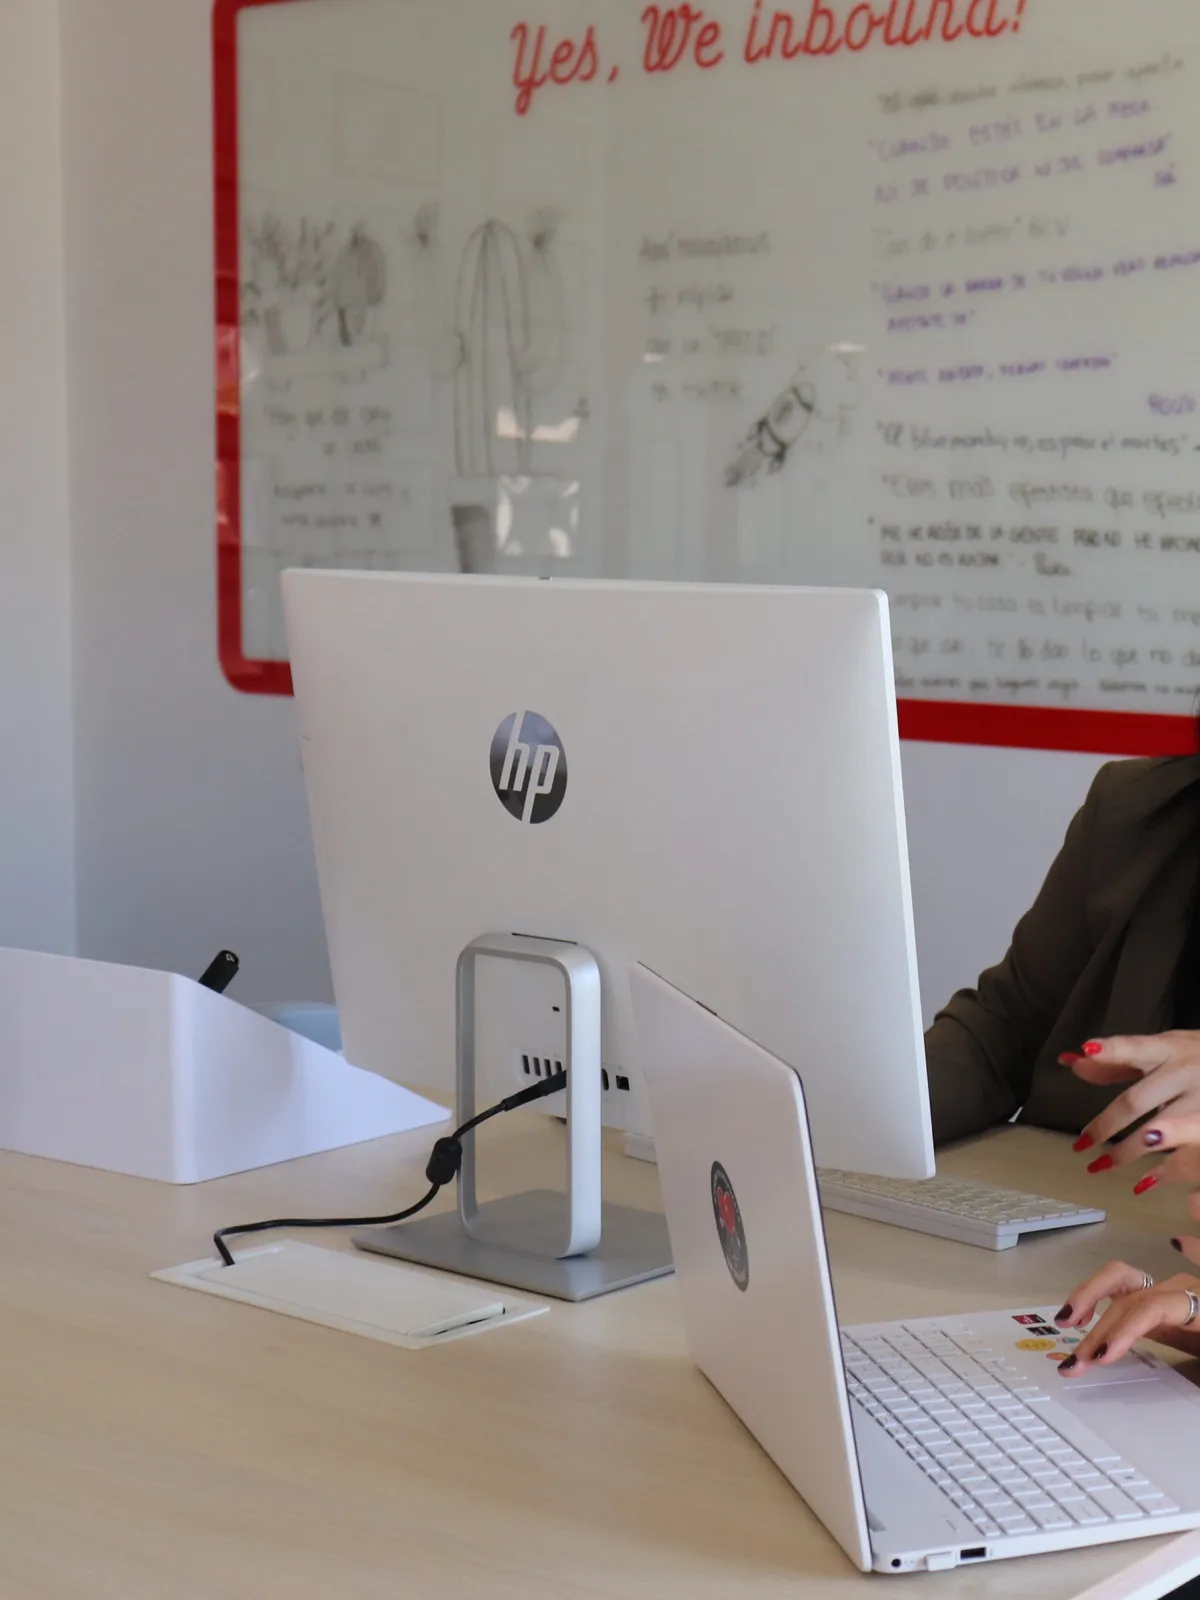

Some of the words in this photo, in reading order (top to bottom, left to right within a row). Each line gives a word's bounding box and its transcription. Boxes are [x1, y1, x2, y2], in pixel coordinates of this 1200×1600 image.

[509, 22, 619, 116] Yes,
[640, 3, 724, 72] We
[499, 710, 560, 822] hp
